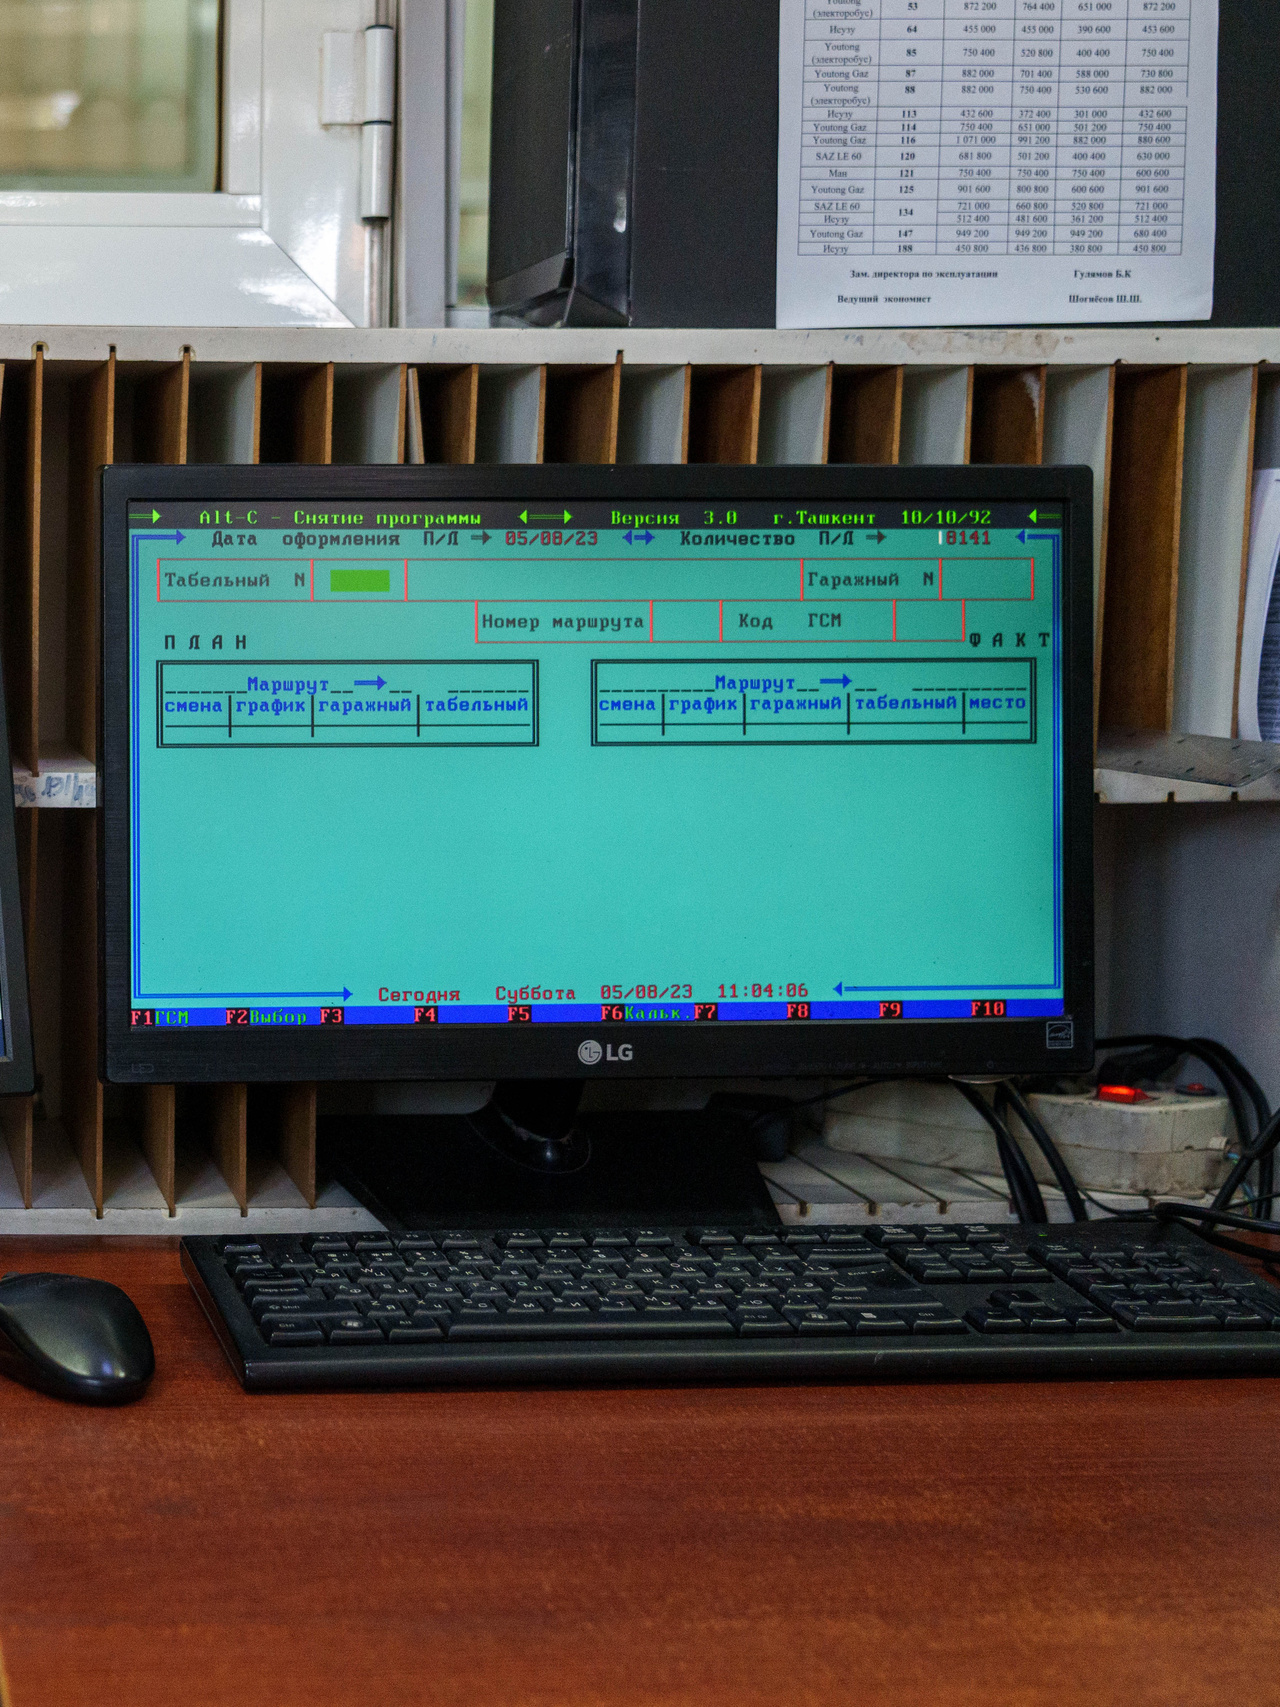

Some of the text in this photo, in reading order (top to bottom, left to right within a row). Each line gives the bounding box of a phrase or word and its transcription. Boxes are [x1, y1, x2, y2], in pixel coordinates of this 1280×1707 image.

[815, 152, 1050, 161] SAZ LE 60 120 681 800 501 200
[849, 270, 870, 278] Зам.
[871, 271, 919, 280] директора
[936, 271, 998, 280] эксплуатации
[1073, 269, 1113, 280] Гулямов
[837, 295, 879, 305] Ведущий
[294, 511, 363, 525] Снятие
[376, 513, 480, 528] программы
[611, 510, 737, 525] Версия 3.0
[773, 510, 992, 525] г.Ташкент 10/10/92
[211, 531, 598, 549] Дата оформления П/Л 05/08/23
[680, 531, 991, 546] Количество П/Л 8141
[165, 572, 270, 588] Табельный
[807, 571, 899, 589] Гаражный
[482, 614, 644, 631] Номер маршрута
[739, 613, 842, 630] Код ГСМ
[247, 676, 329, 694] Маршрут
[715, 675, 795, 693] Маршрут
[165, 698, 528, 716] смена график гаражный табельный
[599, 696, 1026, 715] смена график гаражный табельный место
[378, 983, 808, 1004] Сегодня Суббота 05/08/23 11:04:06
[320, 1008, 343, 1024] F3
[414, 1007, 436, 1022] F4
[508, 1006, 530, 1021] F5
[786, 1003, 809, 1018] F8
[879, 1002, 901, 1017] F9
[971, 1001, 1005, 1016] F10
[606, 1044, 633, 1061] LG
